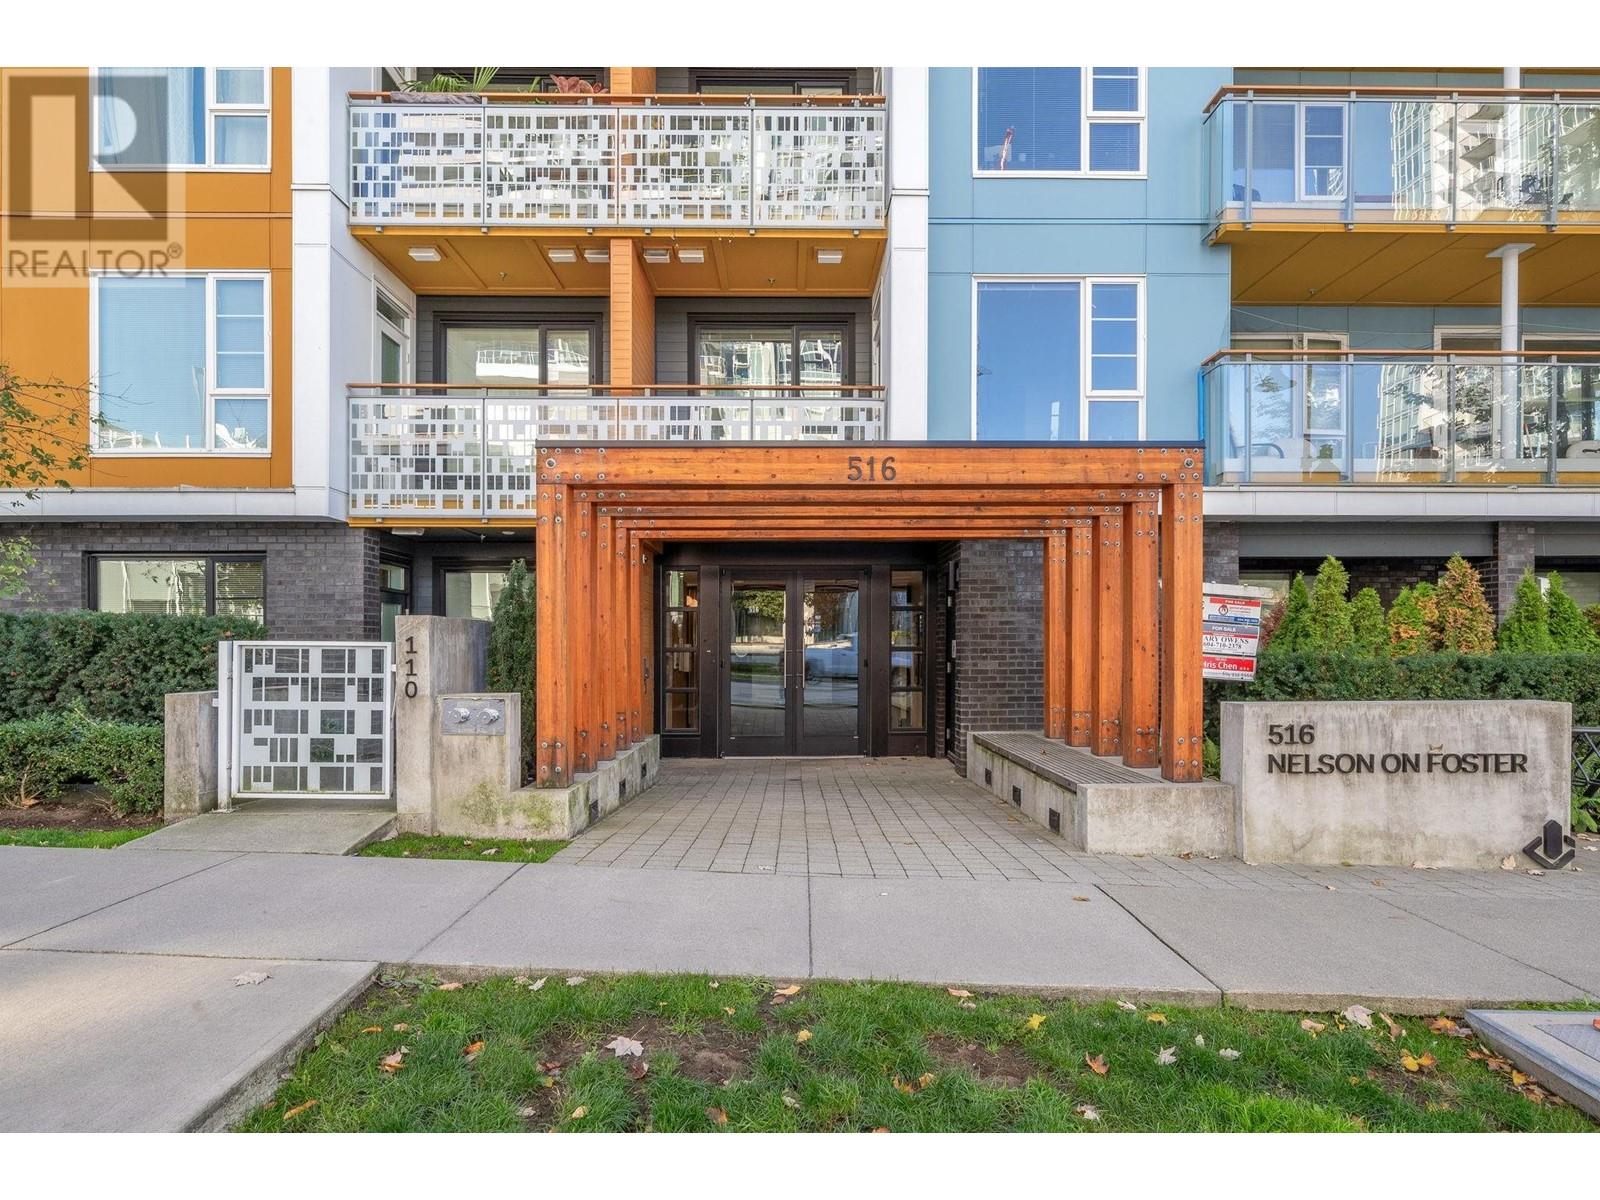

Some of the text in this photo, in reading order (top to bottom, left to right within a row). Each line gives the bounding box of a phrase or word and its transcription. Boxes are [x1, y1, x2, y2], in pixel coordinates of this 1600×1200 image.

[848, 456, 897, 481] 516
[1220, 637, 1249, 645] OWENS
[404, 636, 418, 698] 110
[1218, 661, 1238, 670] Chen
[1268, 724, 1315, 745] 516
[1267, 753, 1529, 774] NELSON ON FOSTER
